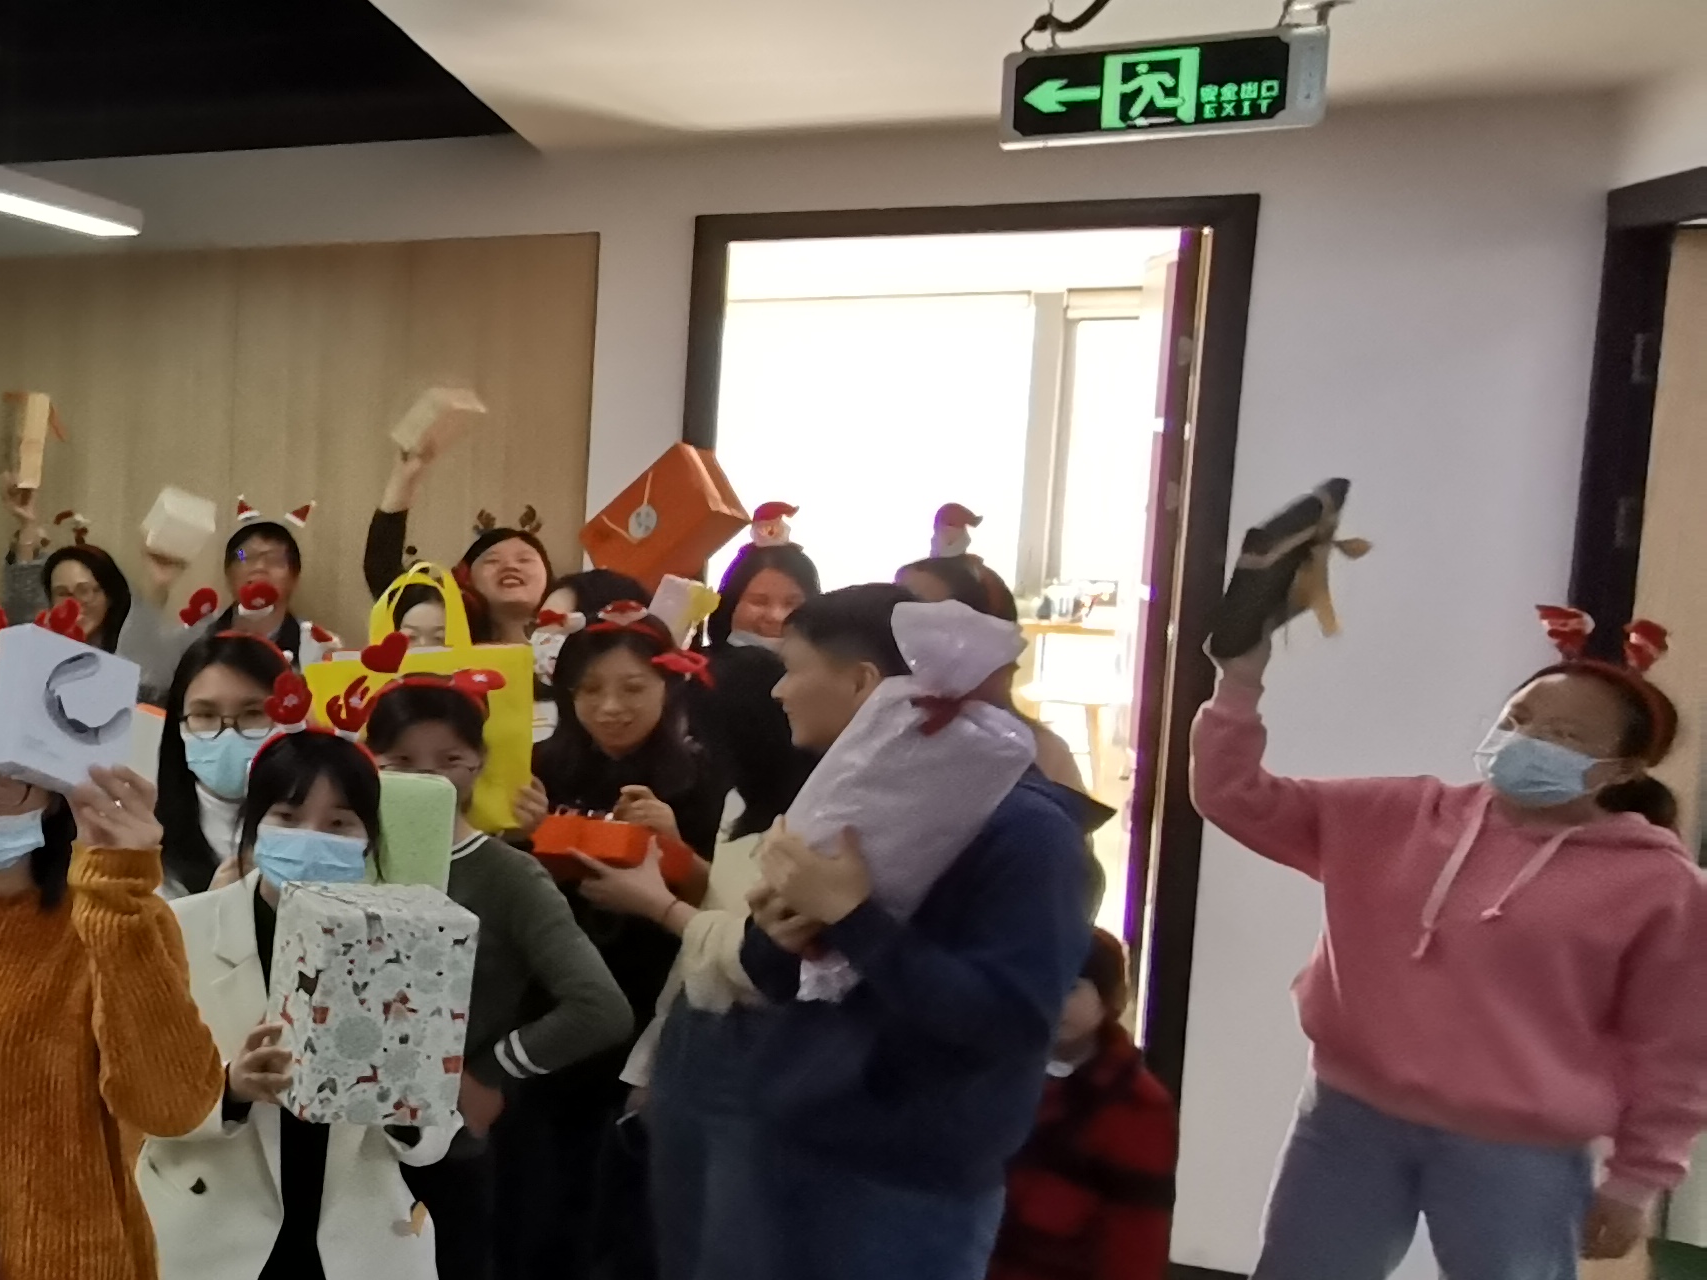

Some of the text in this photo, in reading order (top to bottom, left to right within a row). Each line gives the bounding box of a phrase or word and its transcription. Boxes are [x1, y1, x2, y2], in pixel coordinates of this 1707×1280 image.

[1200, 79, 1280, 104] 安全出口
[1203, 98, 1274, 118] EXIT
